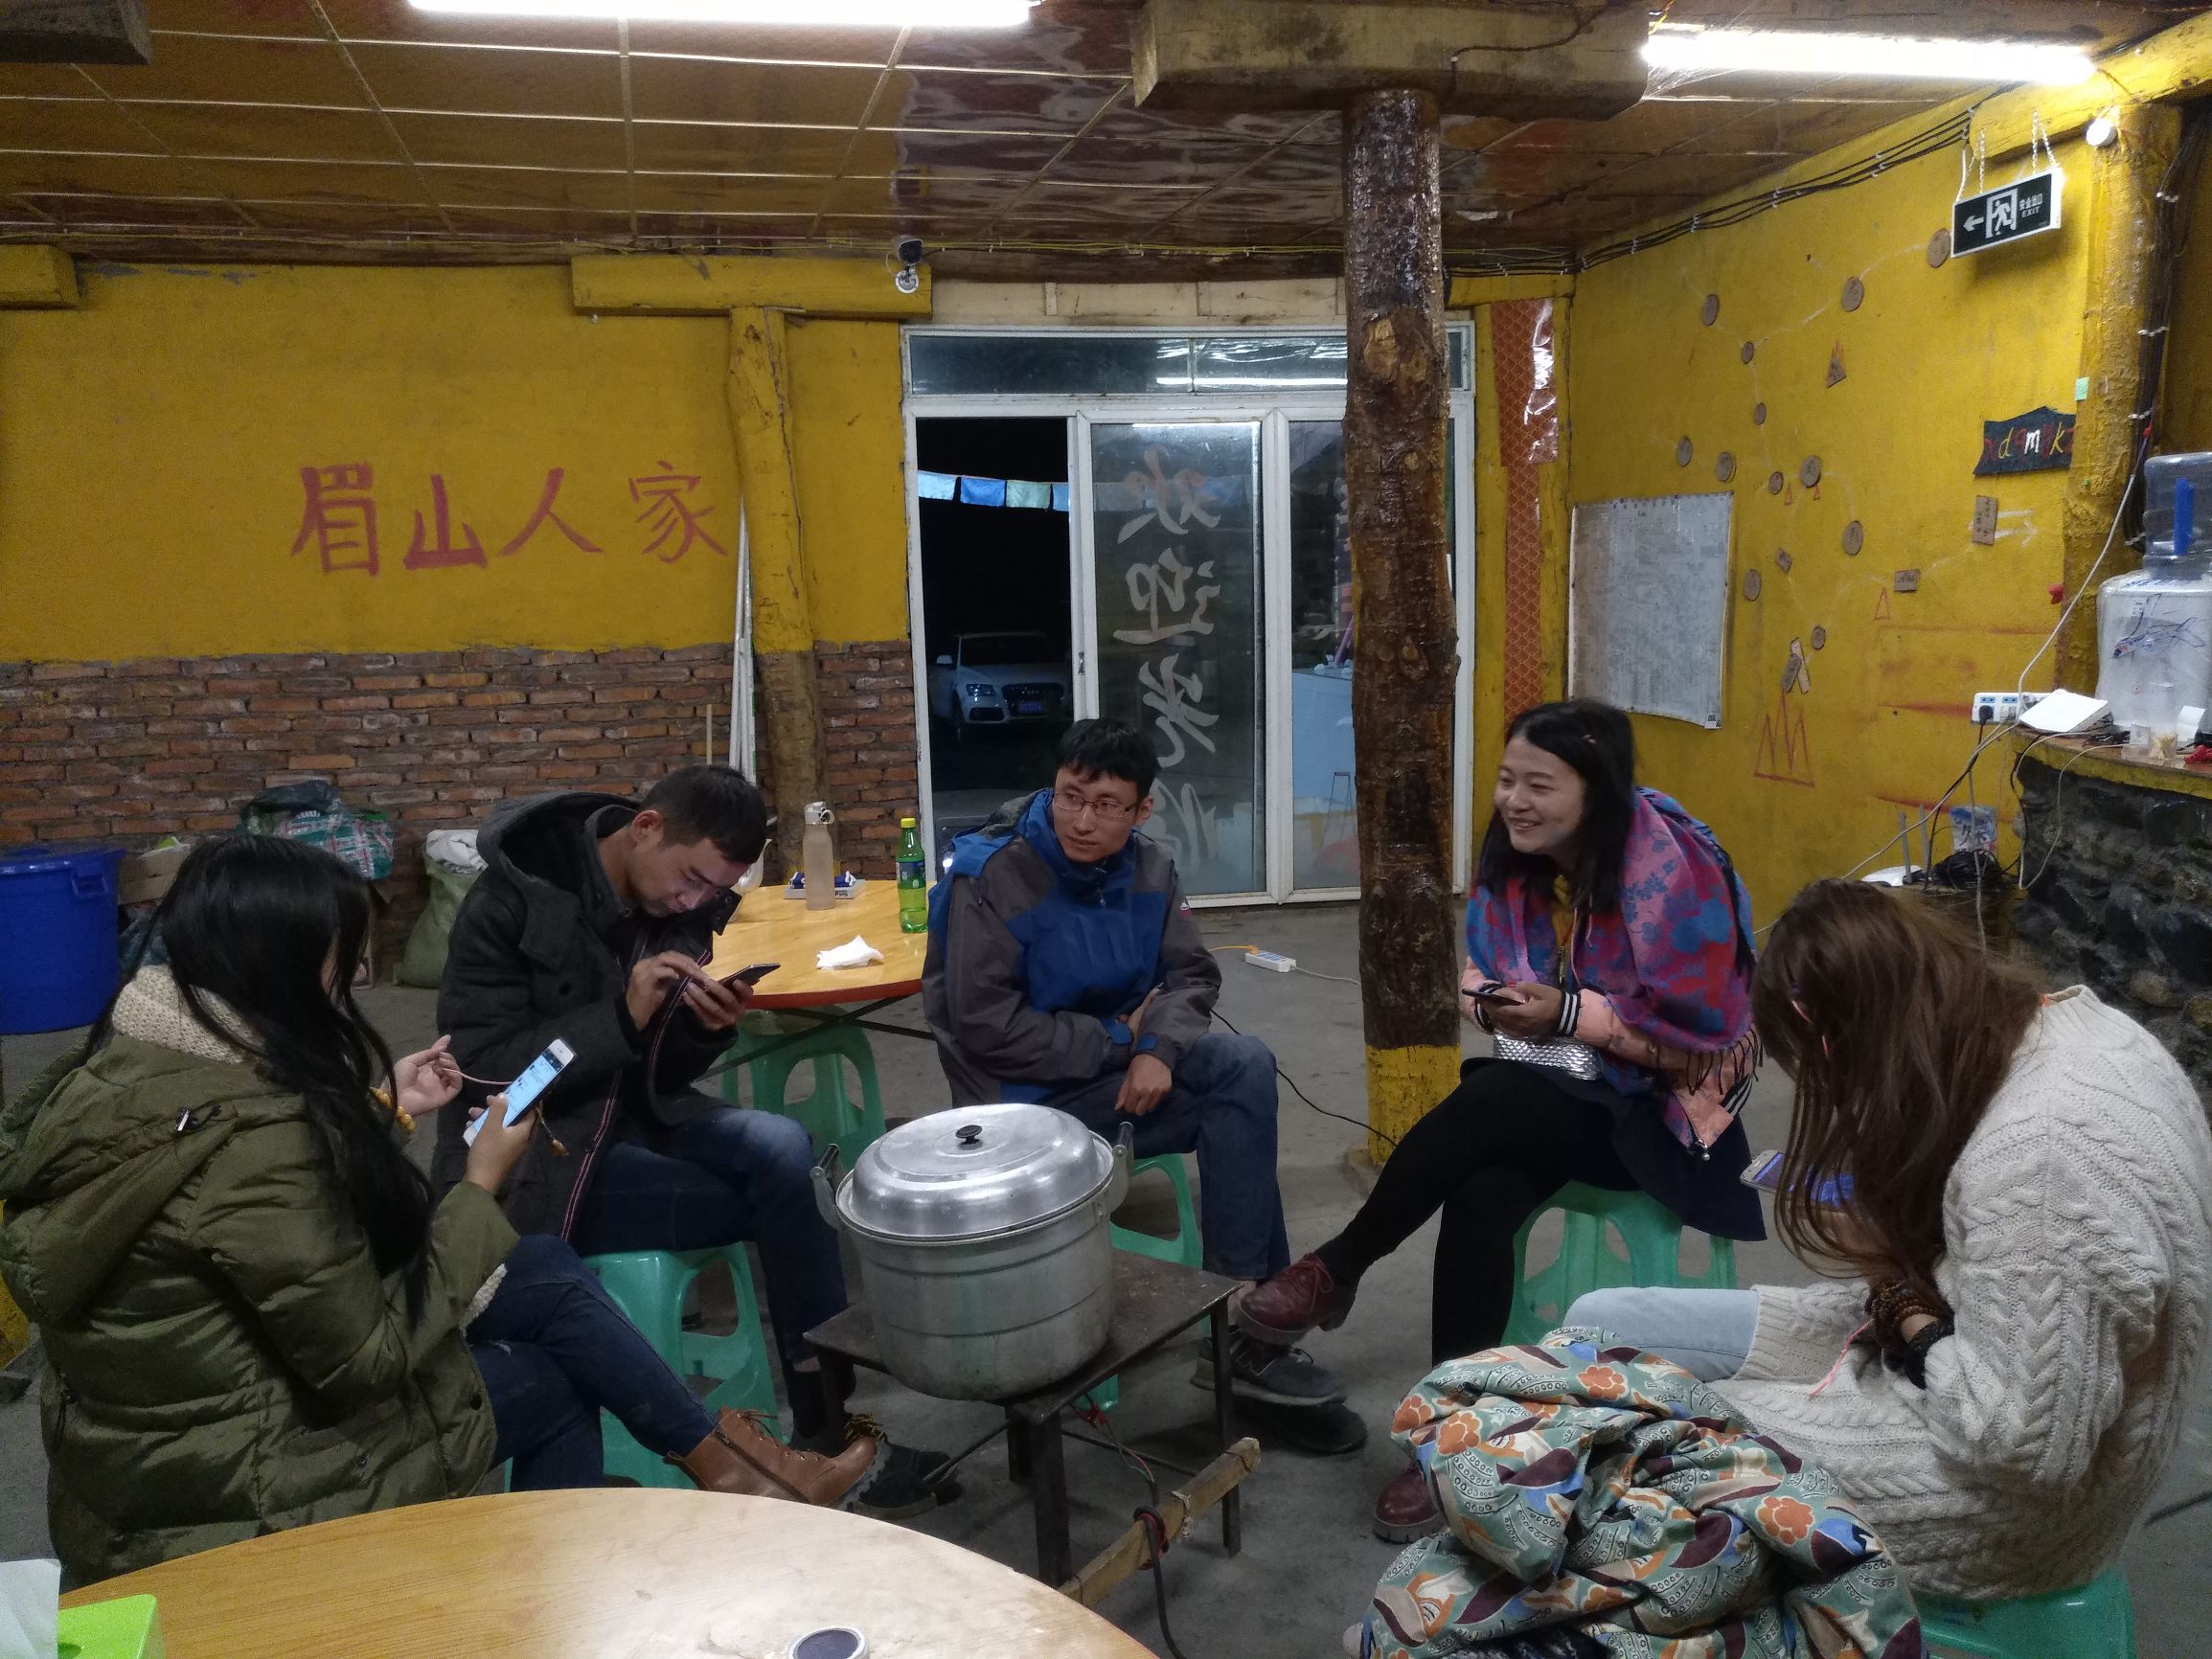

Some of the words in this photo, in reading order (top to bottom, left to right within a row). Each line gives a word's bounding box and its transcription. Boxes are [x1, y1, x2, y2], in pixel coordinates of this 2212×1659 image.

[2021, 206, 2041, 218] EXIT
[291, 461, 727, 576] 眉山人家
